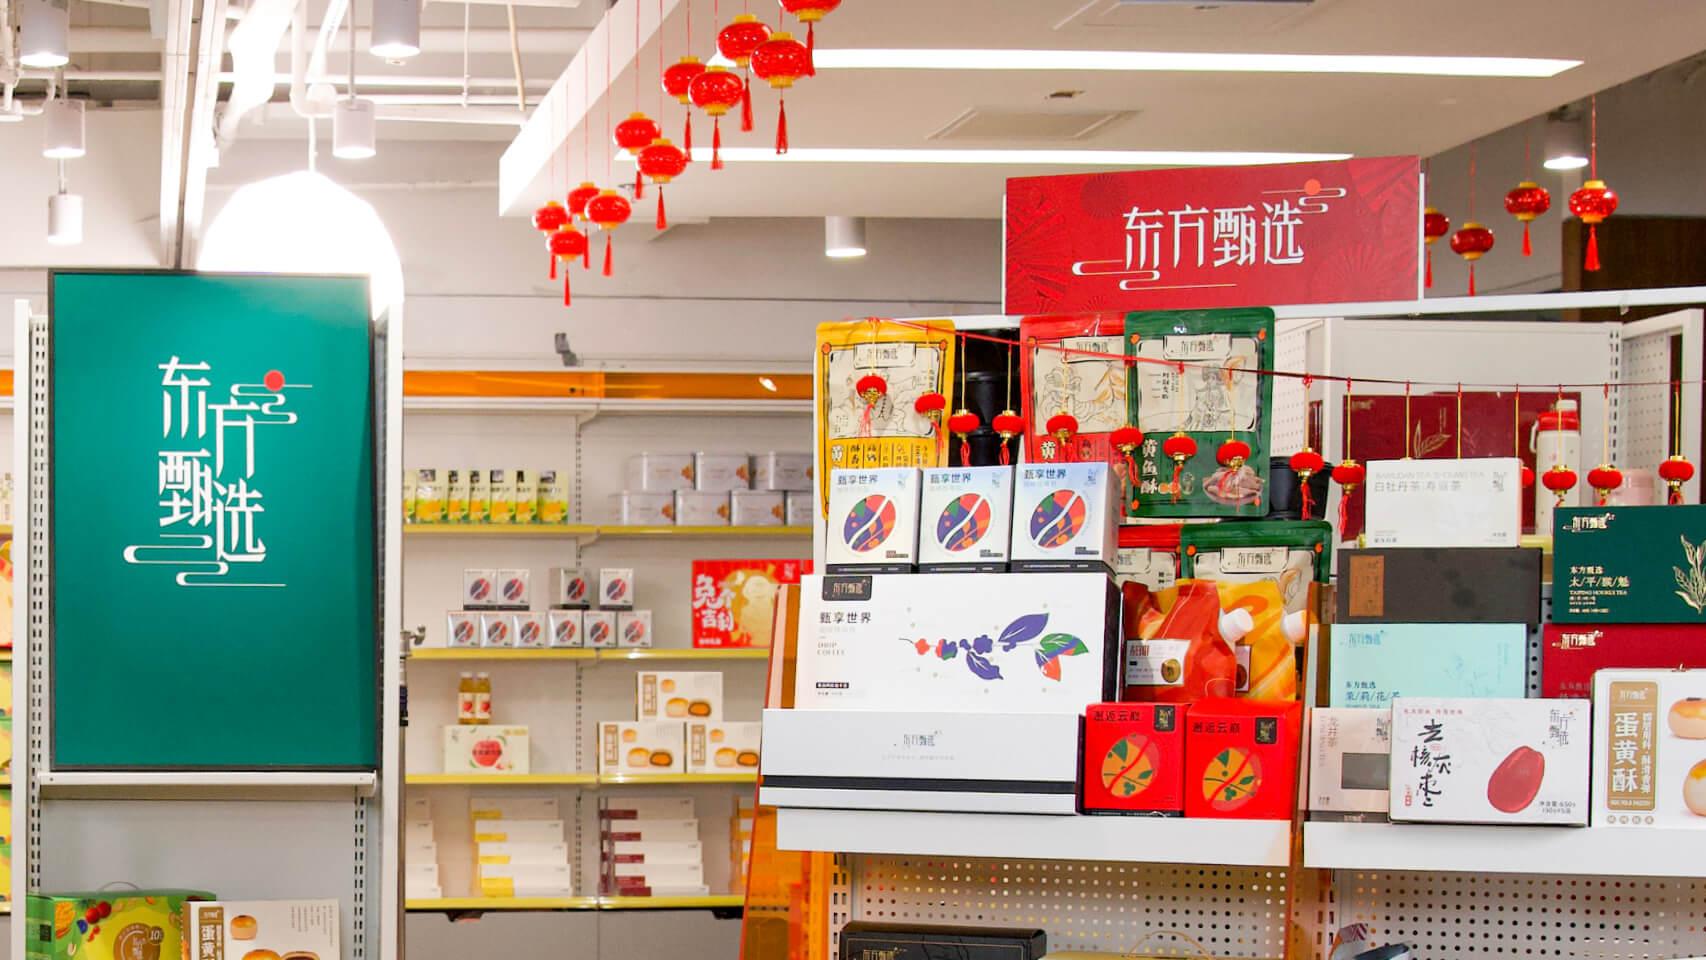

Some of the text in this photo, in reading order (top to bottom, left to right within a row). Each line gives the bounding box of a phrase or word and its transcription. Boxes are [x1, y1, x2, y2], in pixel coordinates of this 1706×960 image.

[1122, 200, 1304, 270] 东方甄选
[838, 474, 879, 485] 甄享世界
[930, 473, 972, 484] 甄享世界
[1024, 468, 1067, 480] 甄享世界
[819, 612, 871, 624] 甄享世界
[1612, 712, 1639, 793] 蛋黄酥
